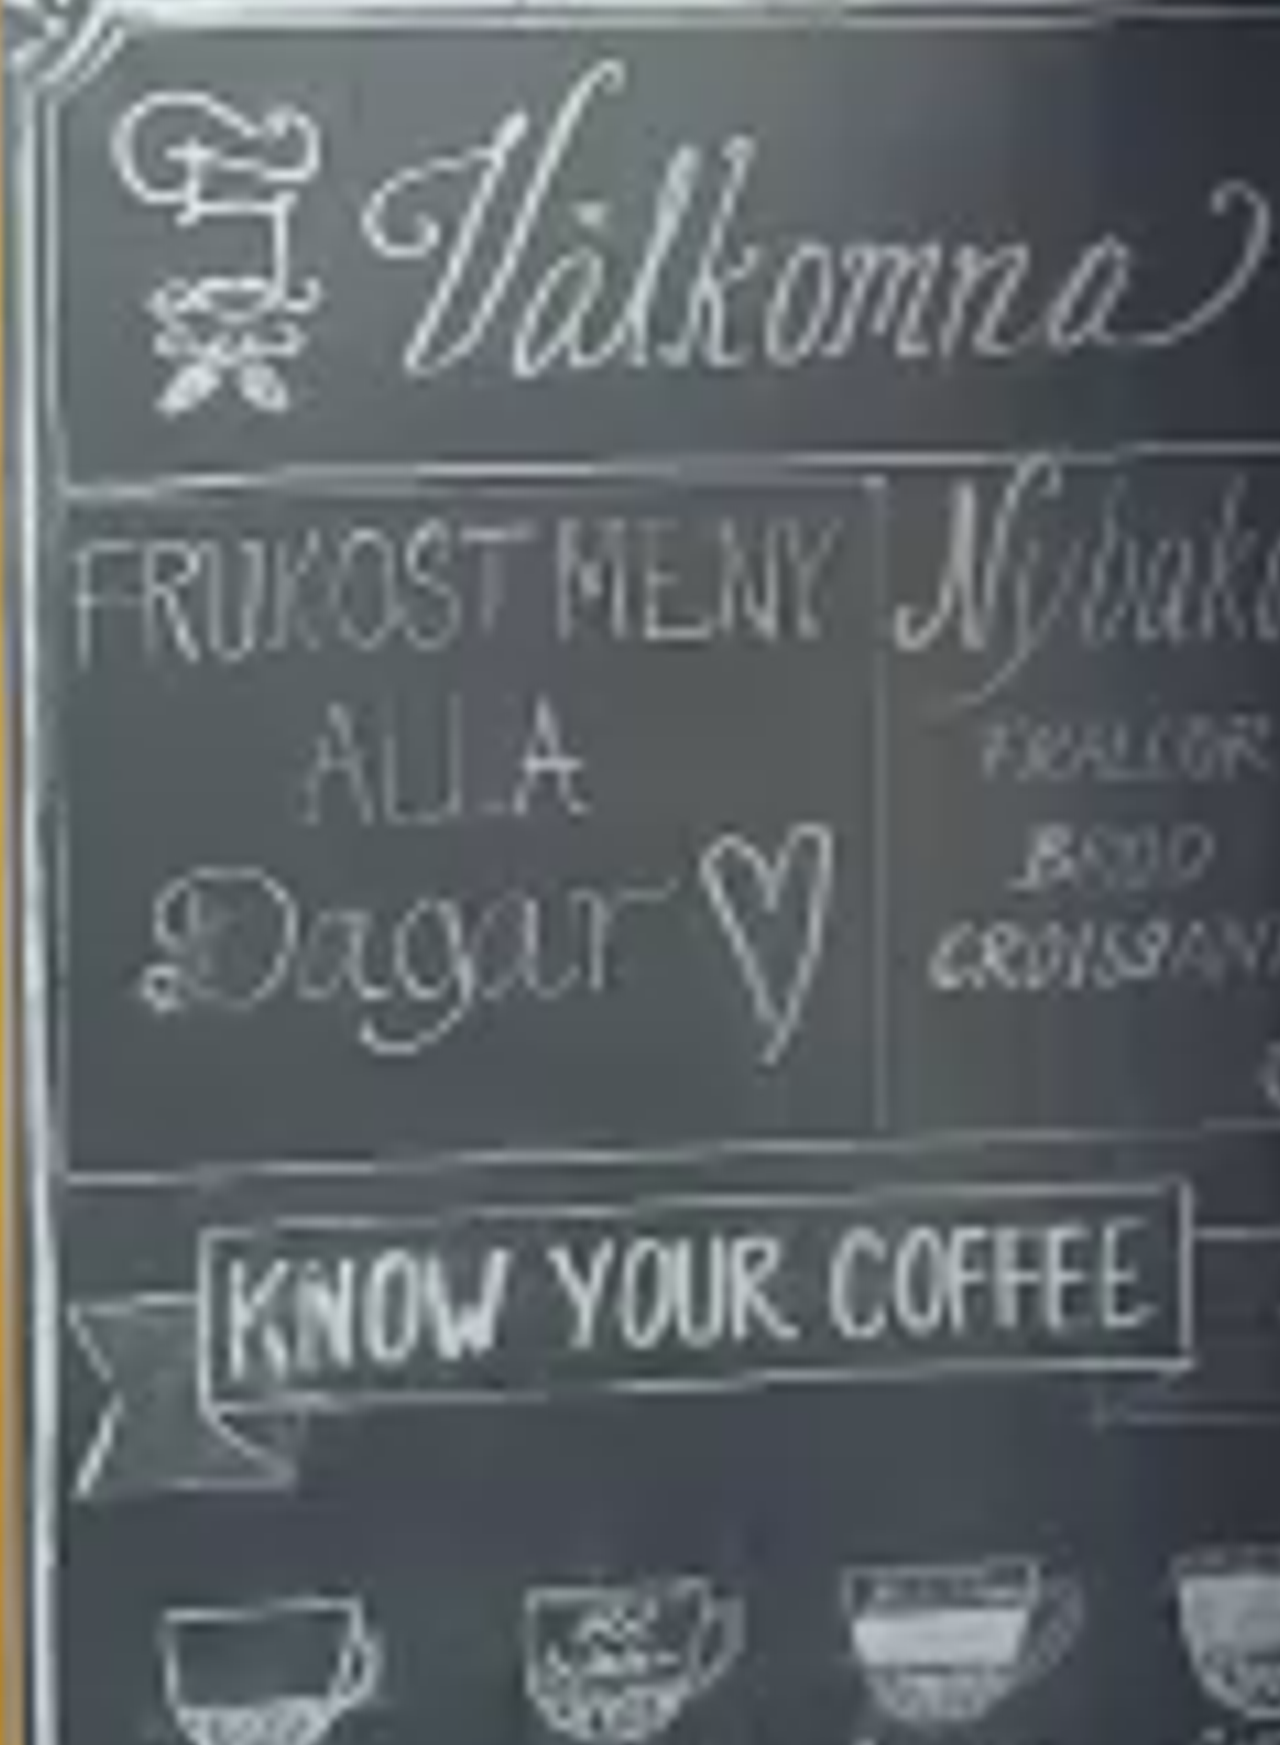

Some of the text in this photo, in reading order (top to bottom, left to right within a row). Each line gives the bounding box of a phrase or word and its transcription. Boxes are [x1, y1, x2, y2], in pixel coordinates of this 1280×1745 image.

[360, 59, 1272, 379] Välkomna
[302, 699, 595, 829] ALLA
[140, 864, 680, 1054] Dagar
[225, 1217, 1160, 1379] KNOW YOUR COFFEE
